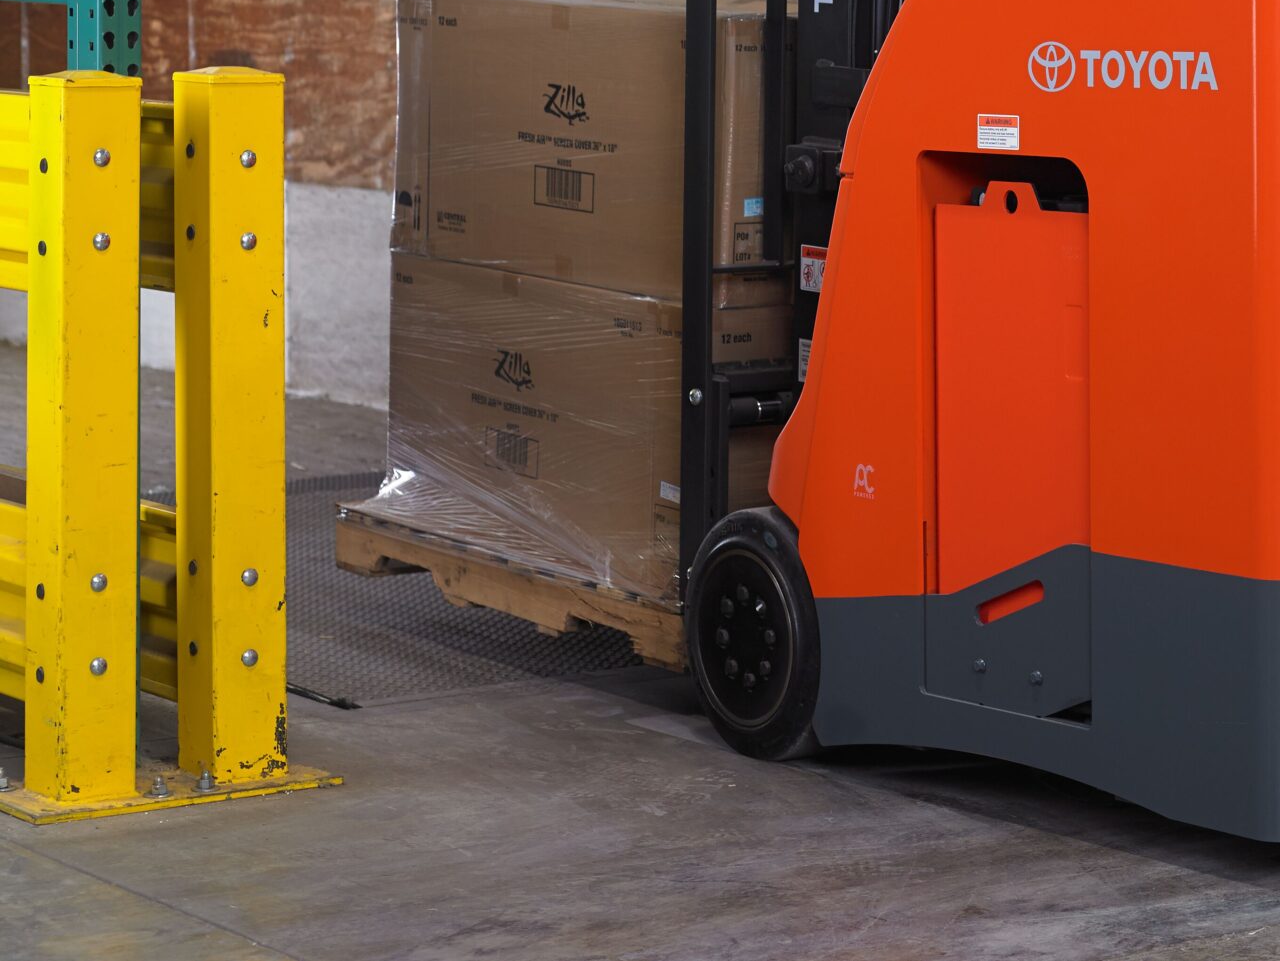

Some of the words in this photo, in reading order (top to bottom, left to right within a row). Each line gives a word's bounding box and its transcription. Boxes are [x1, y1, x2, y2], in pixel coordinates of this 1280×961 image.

[735, 44, 743, 52] 12
[743, 43, 758, 52] each
[1080, 49, 1219, 91] TOYOTA
[543, 82, 590, 126] Zilla
[574, 139, 593, 151] COVER
[721, 334, 732, 344] 12
[733, 333, 752, 344] each
[493, 347, 535, 392] Zilla
